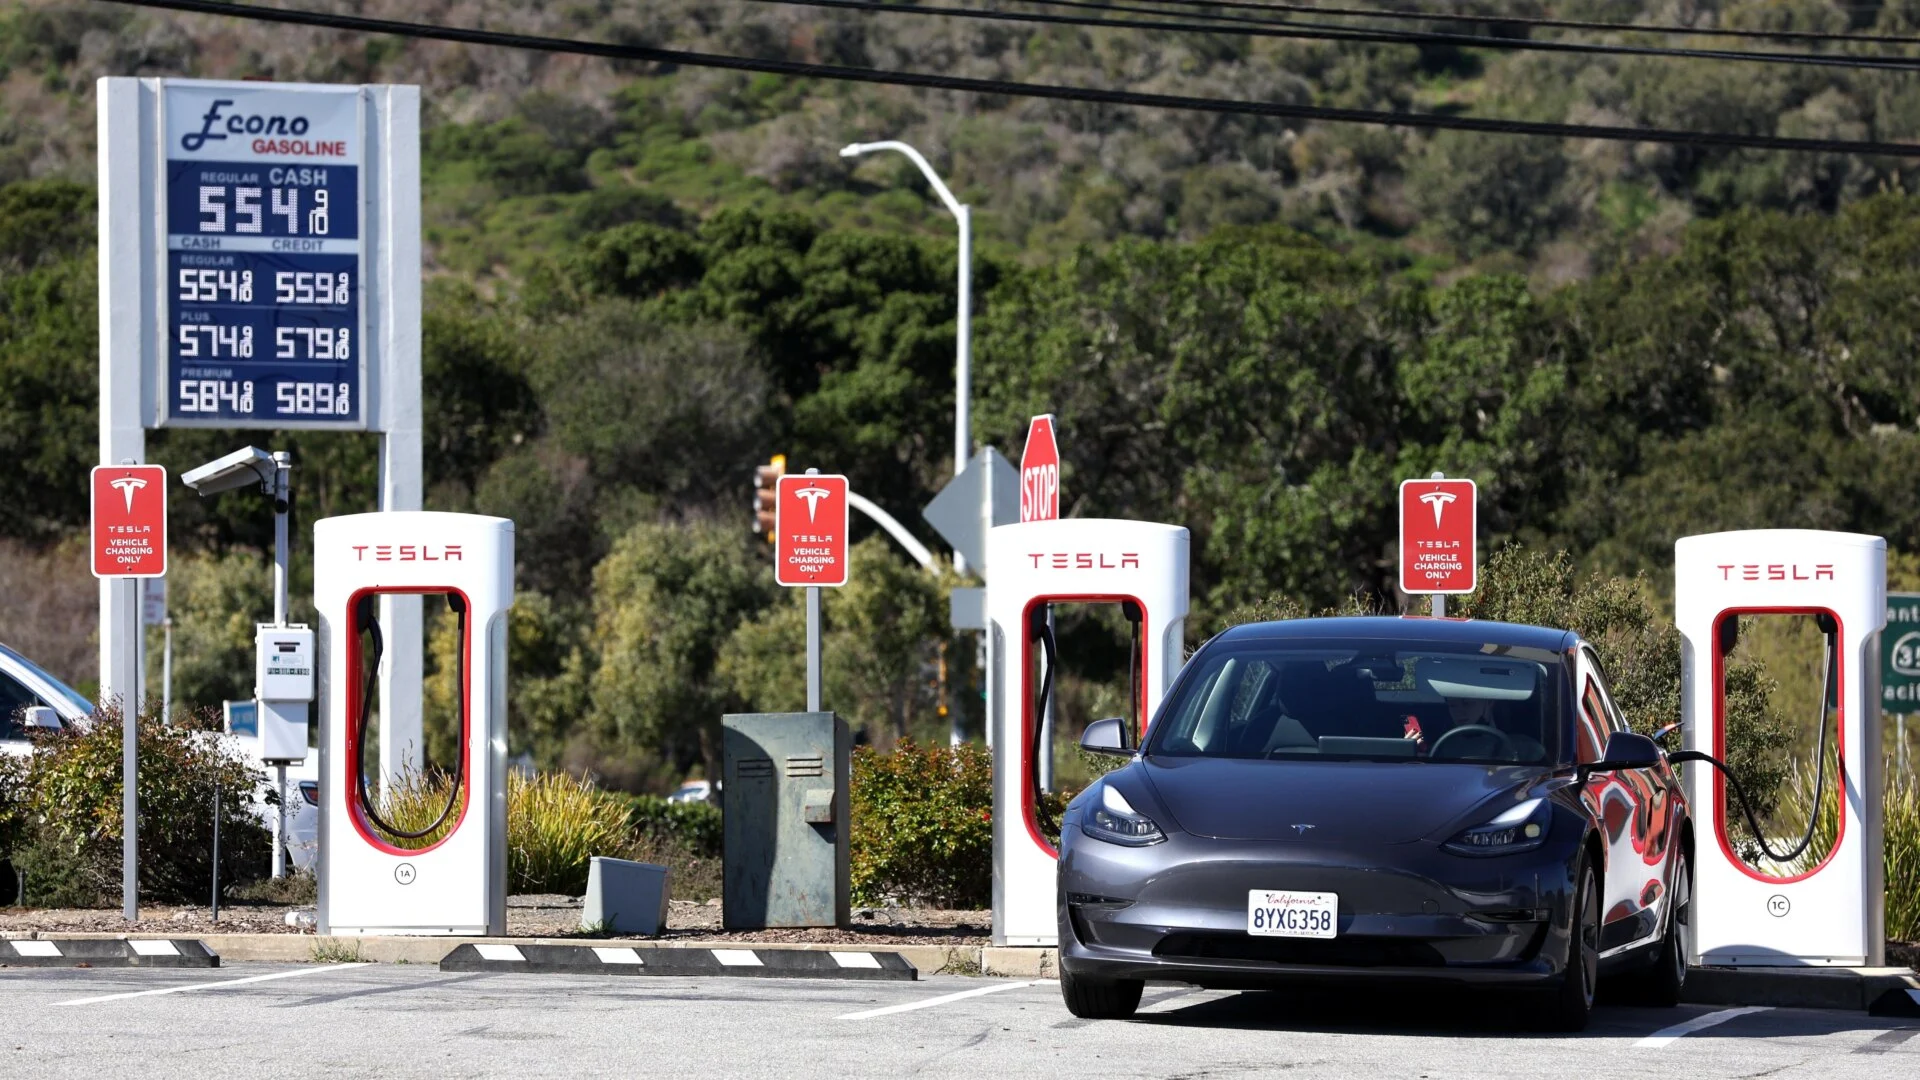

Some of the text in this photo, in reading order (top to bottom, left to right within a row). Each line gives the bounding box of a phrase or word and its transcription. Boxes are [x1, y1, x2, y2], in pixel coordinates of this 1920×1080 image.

[181, 99, 310, 152] Econo
[252, 138, 347, 157] GASOLINE
[200, 167, 328, 186] REGULAR CASH
[181, 236, 325, 252] CASH CREDIT
[181, 255, 234, 266] REGULAR
[181, 311, 210, 322] PLUS
[181, 367, 232, 379] PREMIUM
[1023, 463, 1057, 522] STOP
[110, 538, 149, 546] VEHICLE
[792, 535, 833, 543] TESLA
[105, 547, 153, 555] CHARGING
[352, 545, 462, 561] TESLA
[793, 547, 831, 555] VEHICLE
[788, 556, 835, 564] CHARGING
[1027, 553, 1139, 569] TESLA
[1419, 554, 1458, 562] VEHICLE
[1414, 562, 1463, 570] CHARGING
[1425, 571, 1451, 579] ONLY
[1717, 564, 1833, 581] TESLA
[1886, 605, 1920, 622] ant
[1881, 682, 1920, 701] aci
[400, 870, 411, 878] 1A
[1267, 893, 1320, 907] California
[1772, 901, 1785, 910] 1C
[1254, 907, 1331, 931] 8YXG358
